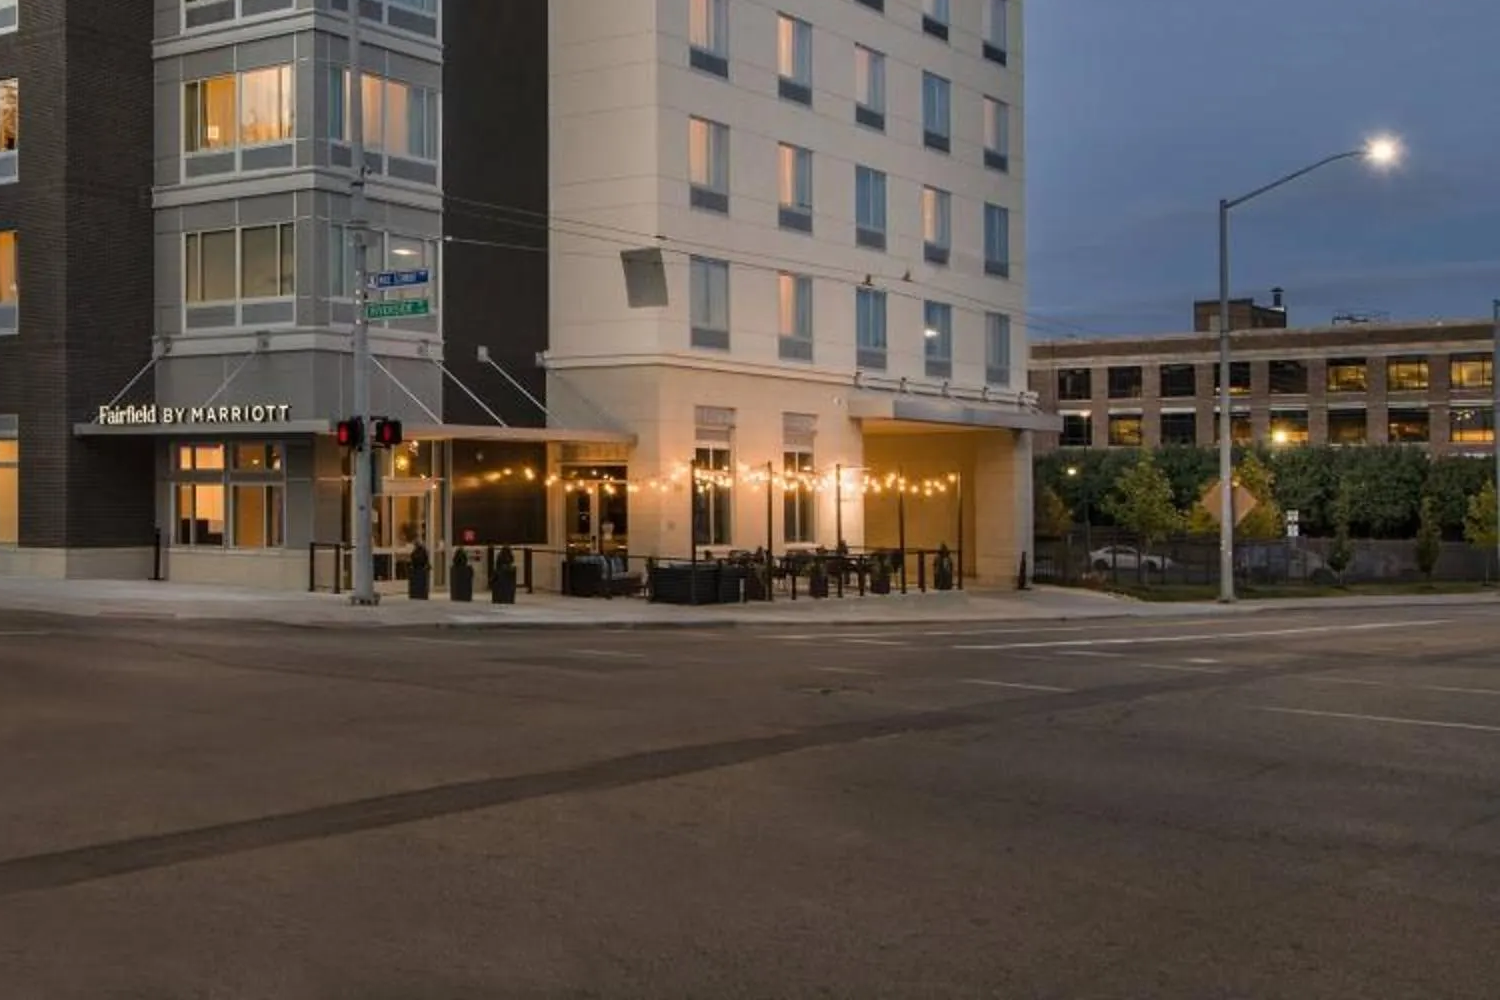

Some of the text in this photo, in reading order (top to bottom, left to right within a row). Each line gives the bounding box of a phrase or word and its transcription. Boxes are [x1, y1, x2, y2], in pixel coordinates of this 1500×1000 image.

[99, 404, 290, 425] Fairfield BY MARRIOTT
